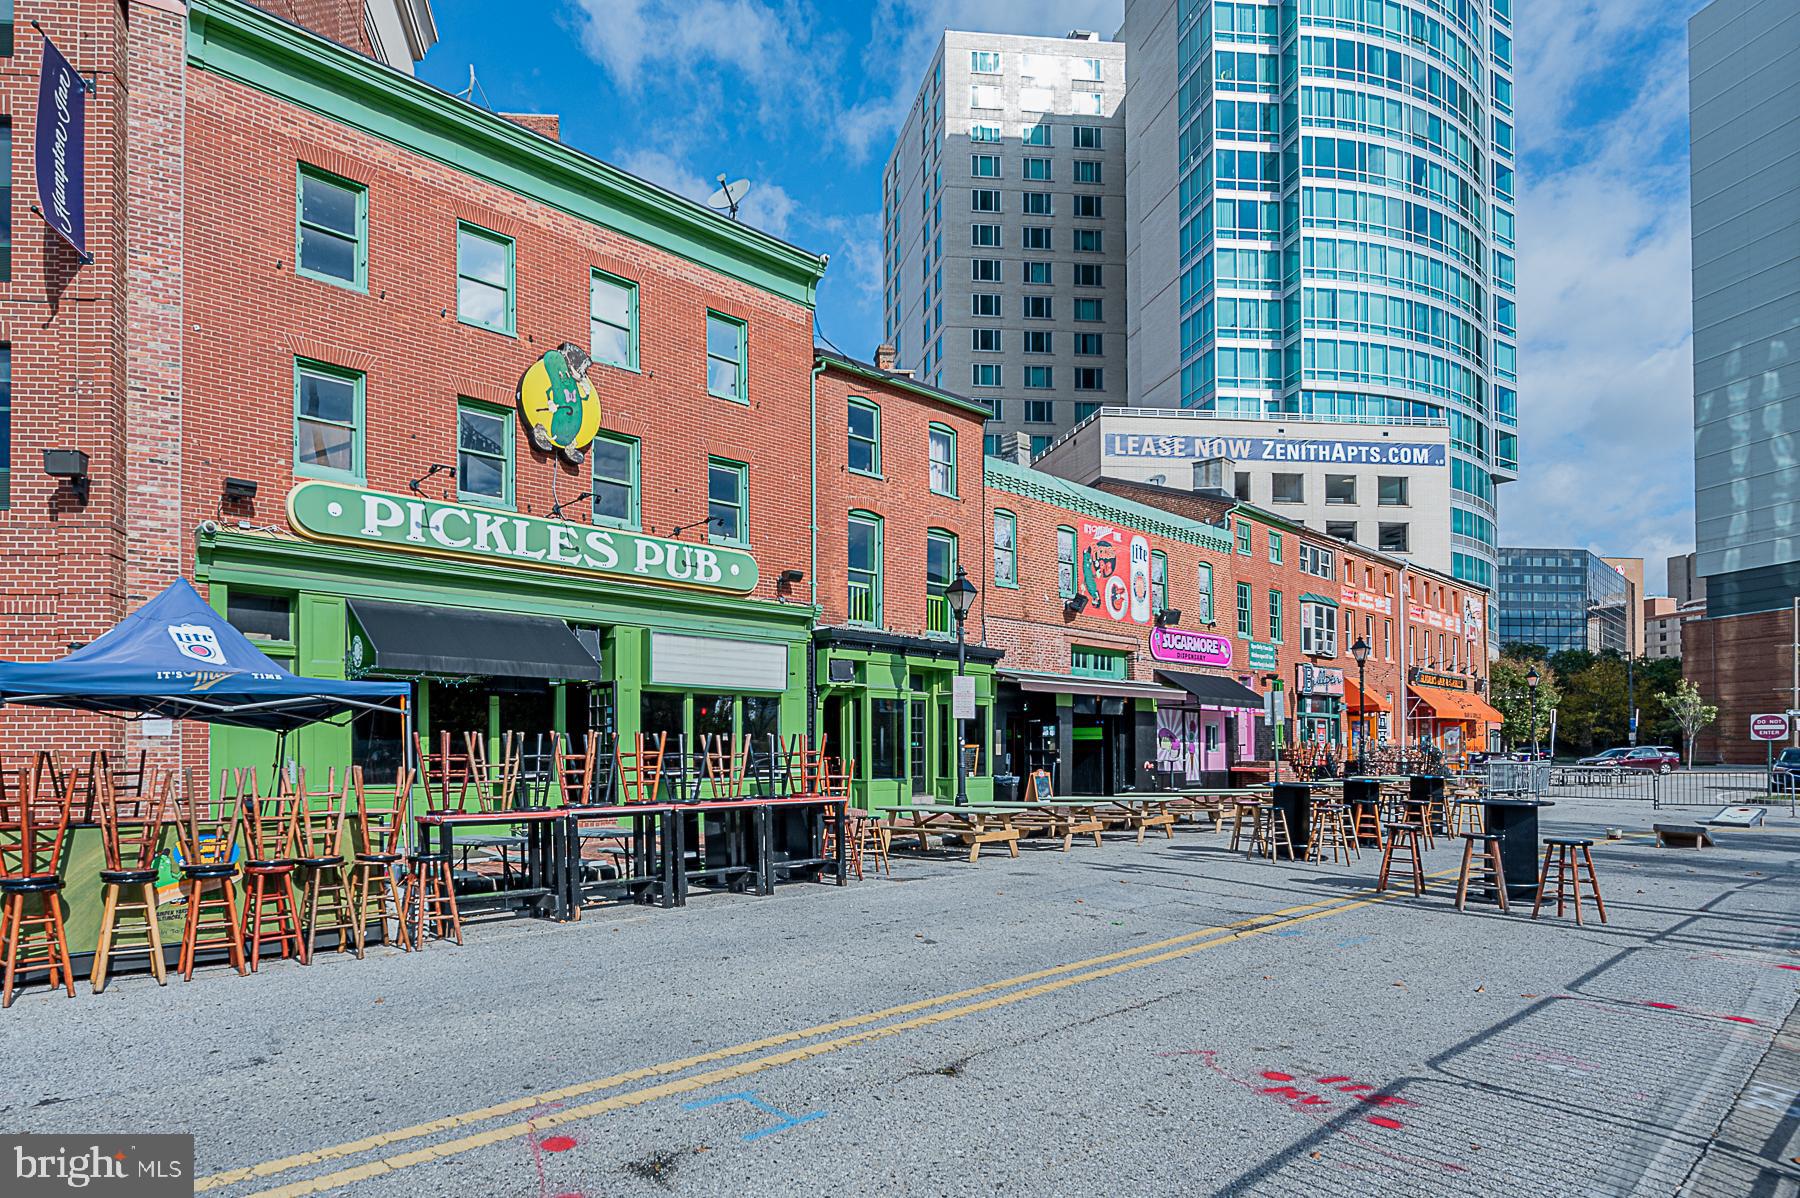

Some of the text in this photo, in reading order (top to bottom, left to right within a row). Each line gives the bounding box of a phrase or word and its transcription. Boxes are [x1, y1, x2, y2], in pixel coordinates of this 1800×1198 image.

[52, 67, 75, 243] Hampton Inn
[1114, 436, 1186, 457] LEASE
[1194, 440, 1252, 460] NOW
[360, 494, 722, 583] PICKLES PUB
[1162, 633, 1219, 655] SUGARMORE
[156, 671, 183, 680] IT'S
